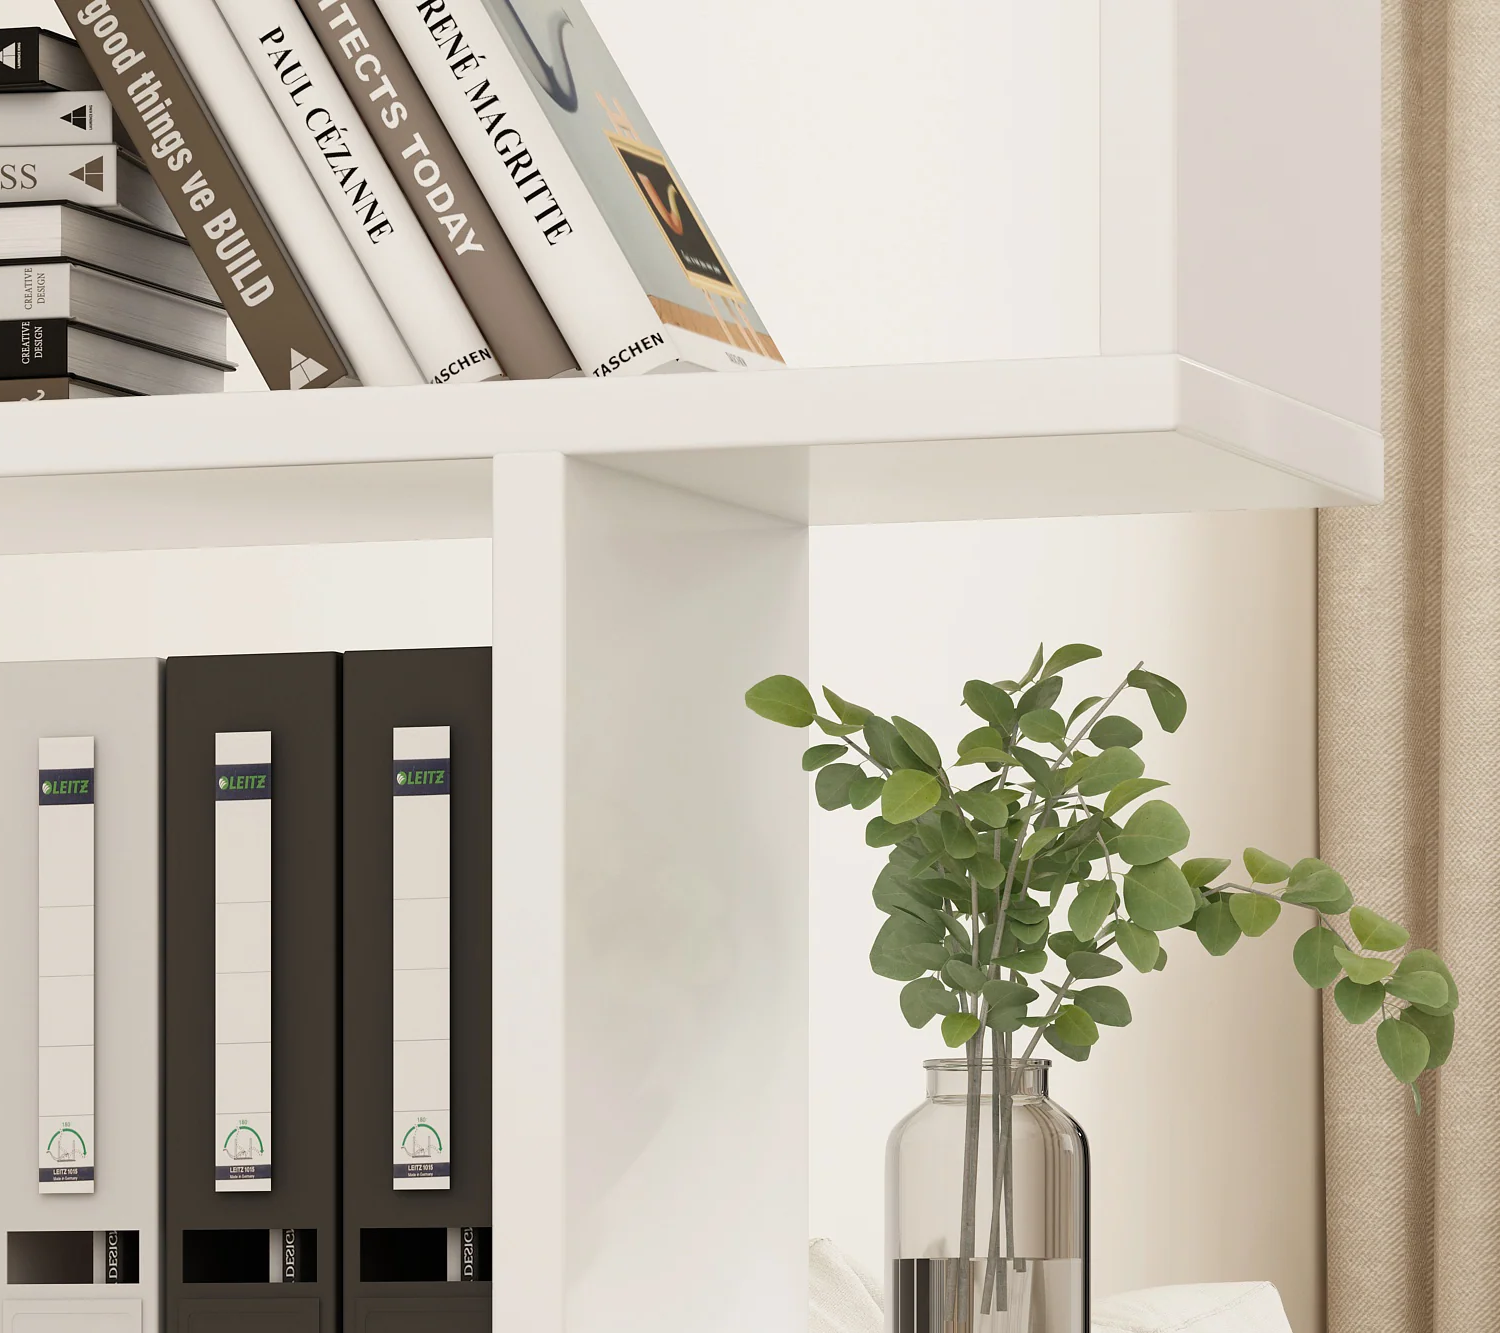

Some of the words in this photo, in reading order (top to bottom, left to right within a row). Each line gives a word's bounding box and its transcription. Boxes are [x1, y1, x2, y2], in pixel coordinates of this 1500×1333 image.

[259, 26, 314, 106] PAUL
[305, 107, 394, 244] CÉZANNE
[416, 0, 486, 80] RENÉ
[465, 79, 573, 245] MAGRITTE
[77, 0, 146, 75] good
[127, 70, 192, 172] things
[181, 170, 214, 211] ve
[203, 207, 274, 307] BUILD
[593, 333, 664, 377] TASCHEN
[53, 780, 89, 794] LEITZ
[229, 775, 266, 789] LEITZ
[408, 771, 445, 784] LEITZ
